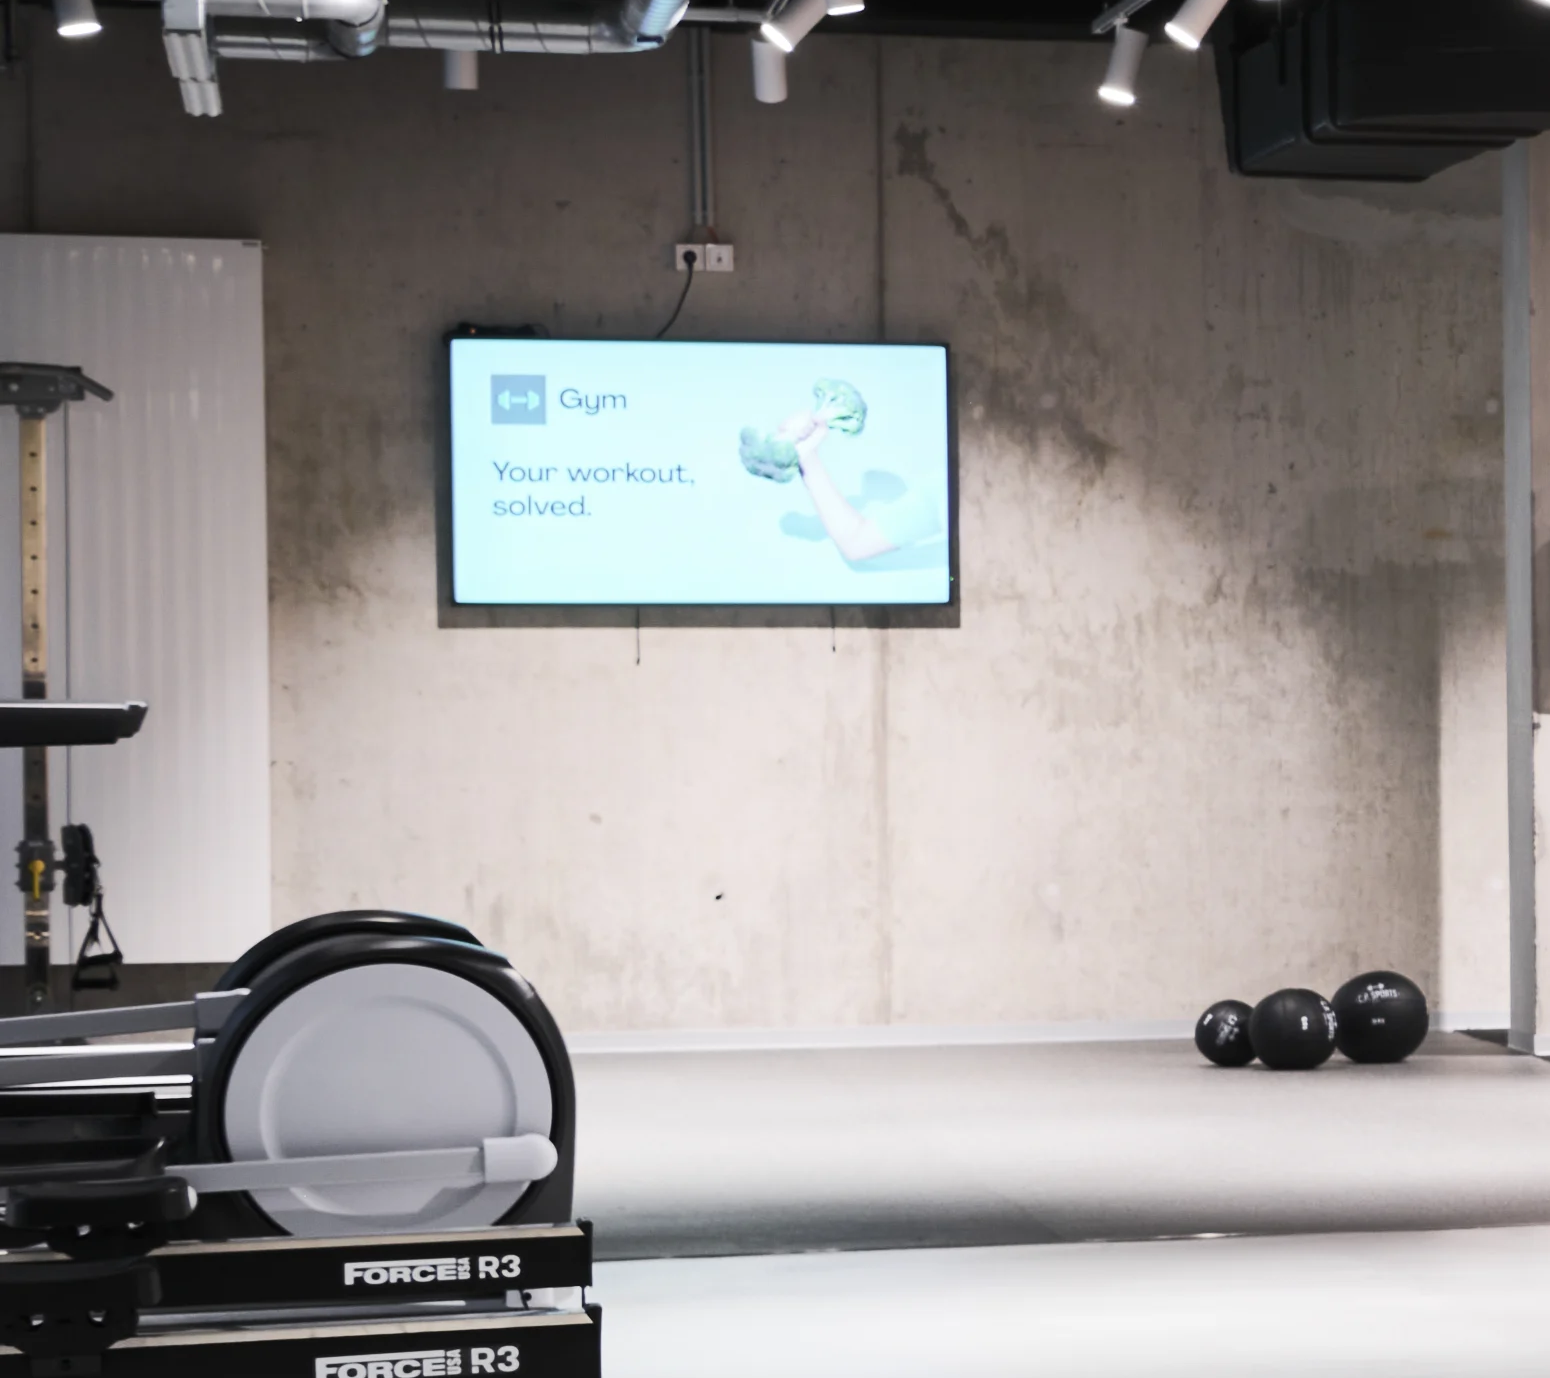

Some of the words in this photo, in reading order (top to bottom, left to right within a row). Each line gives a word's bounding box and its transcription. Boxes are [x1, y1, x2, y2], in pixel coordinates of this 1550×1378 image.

[559, 388, 628, 416] Gym
[492, 461, 558, 483] Your
[567, 462, 696, 486] workout,
[493, 495, 592, 516] solved.
[343, 1257, 457, 1286] FORCE
[457, 1257, 471, 1280] USA
[478, 1254, 521, 1279] R3
[446, 1348, 462, 1376] USA
[470, 1345, 520, 1375] R3
